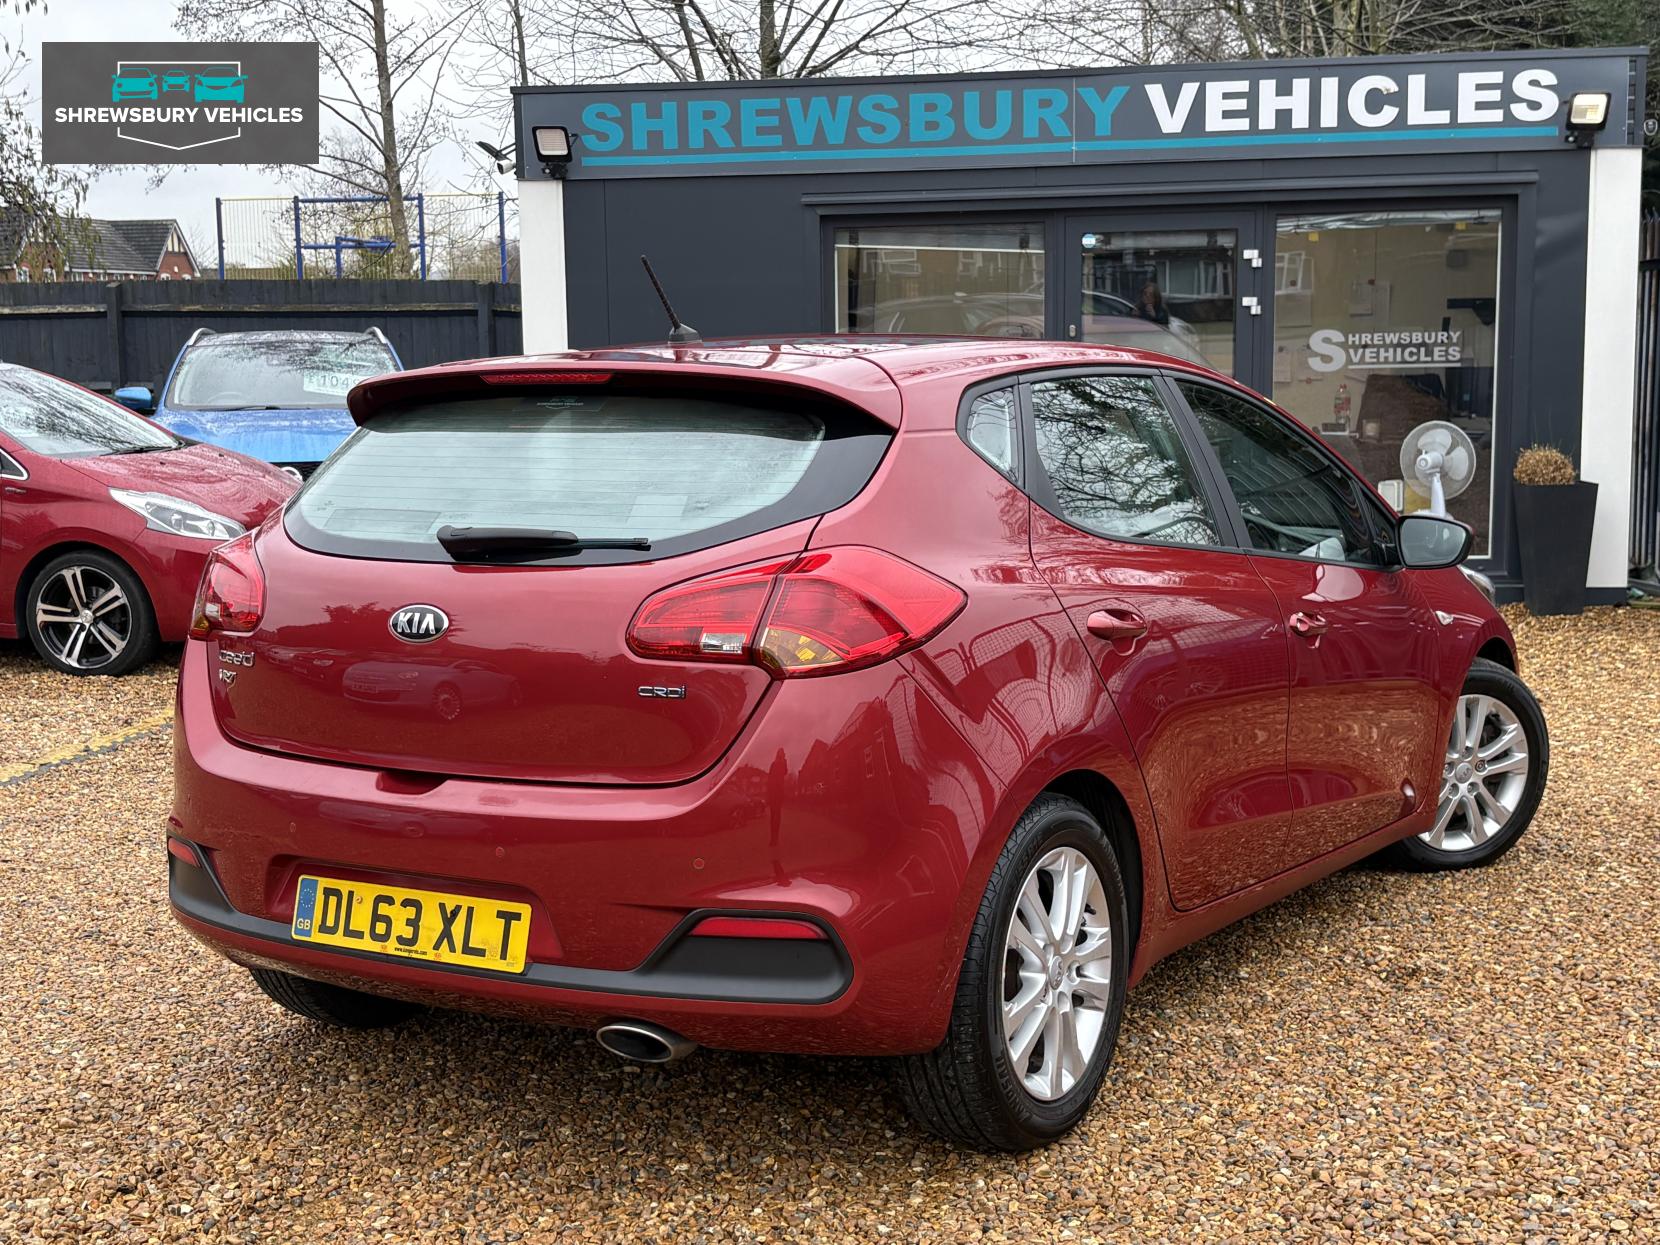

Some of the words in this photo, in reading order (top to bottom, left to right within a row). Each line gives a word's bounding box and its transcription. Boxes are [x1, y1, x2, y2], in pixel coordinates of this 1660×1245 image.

[581, 84, 1131, 151] SHREWSBURY
[1144, 69, 1560, 134] VEHICLES
[1349, 346, 1461, 363] VEHICLES
[397, 612, 436, 635] KIA
[297, 918, 311, 930] GB
[318, 886, 422, 948] DL63
[432, 902, 522, 961] XLT
